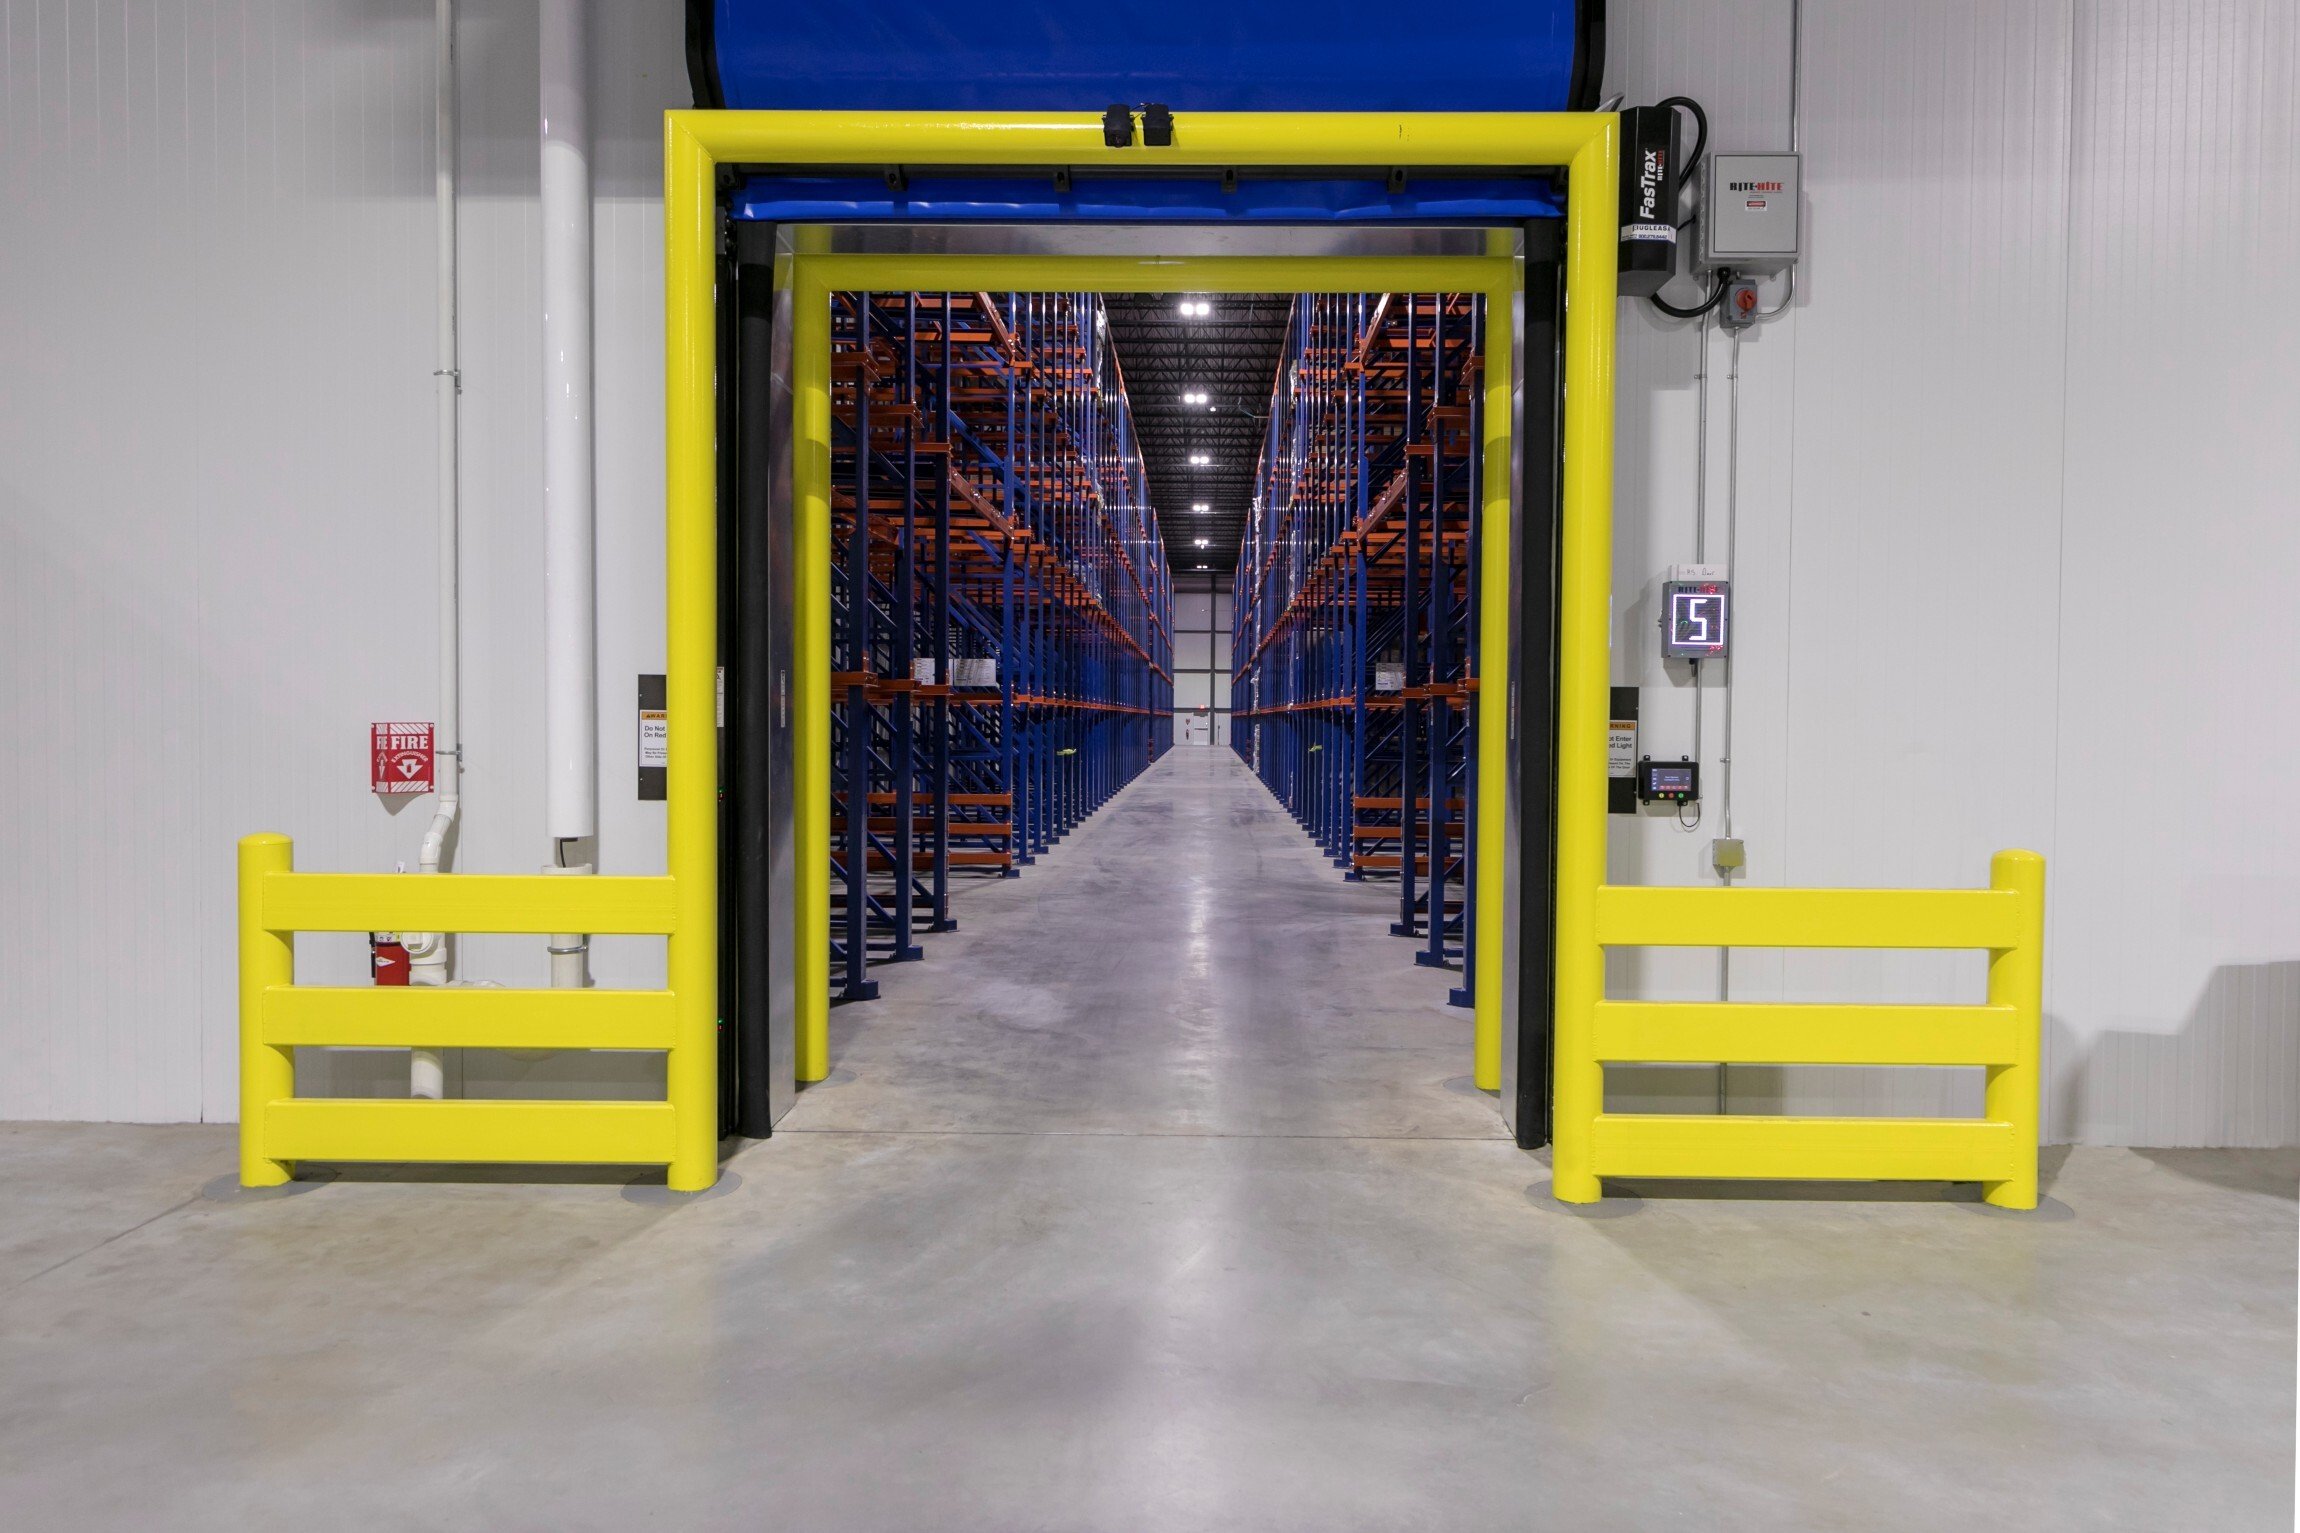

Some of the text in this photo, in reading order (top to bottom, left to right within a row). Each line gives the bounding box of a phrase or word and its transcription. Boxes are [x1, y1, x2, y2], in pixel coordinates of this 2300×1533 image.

[1639, 150, 1657, 219] FasTrax
[1689, 599, 1707, 640] 5
[391, 736, 428, 750] FIRE
